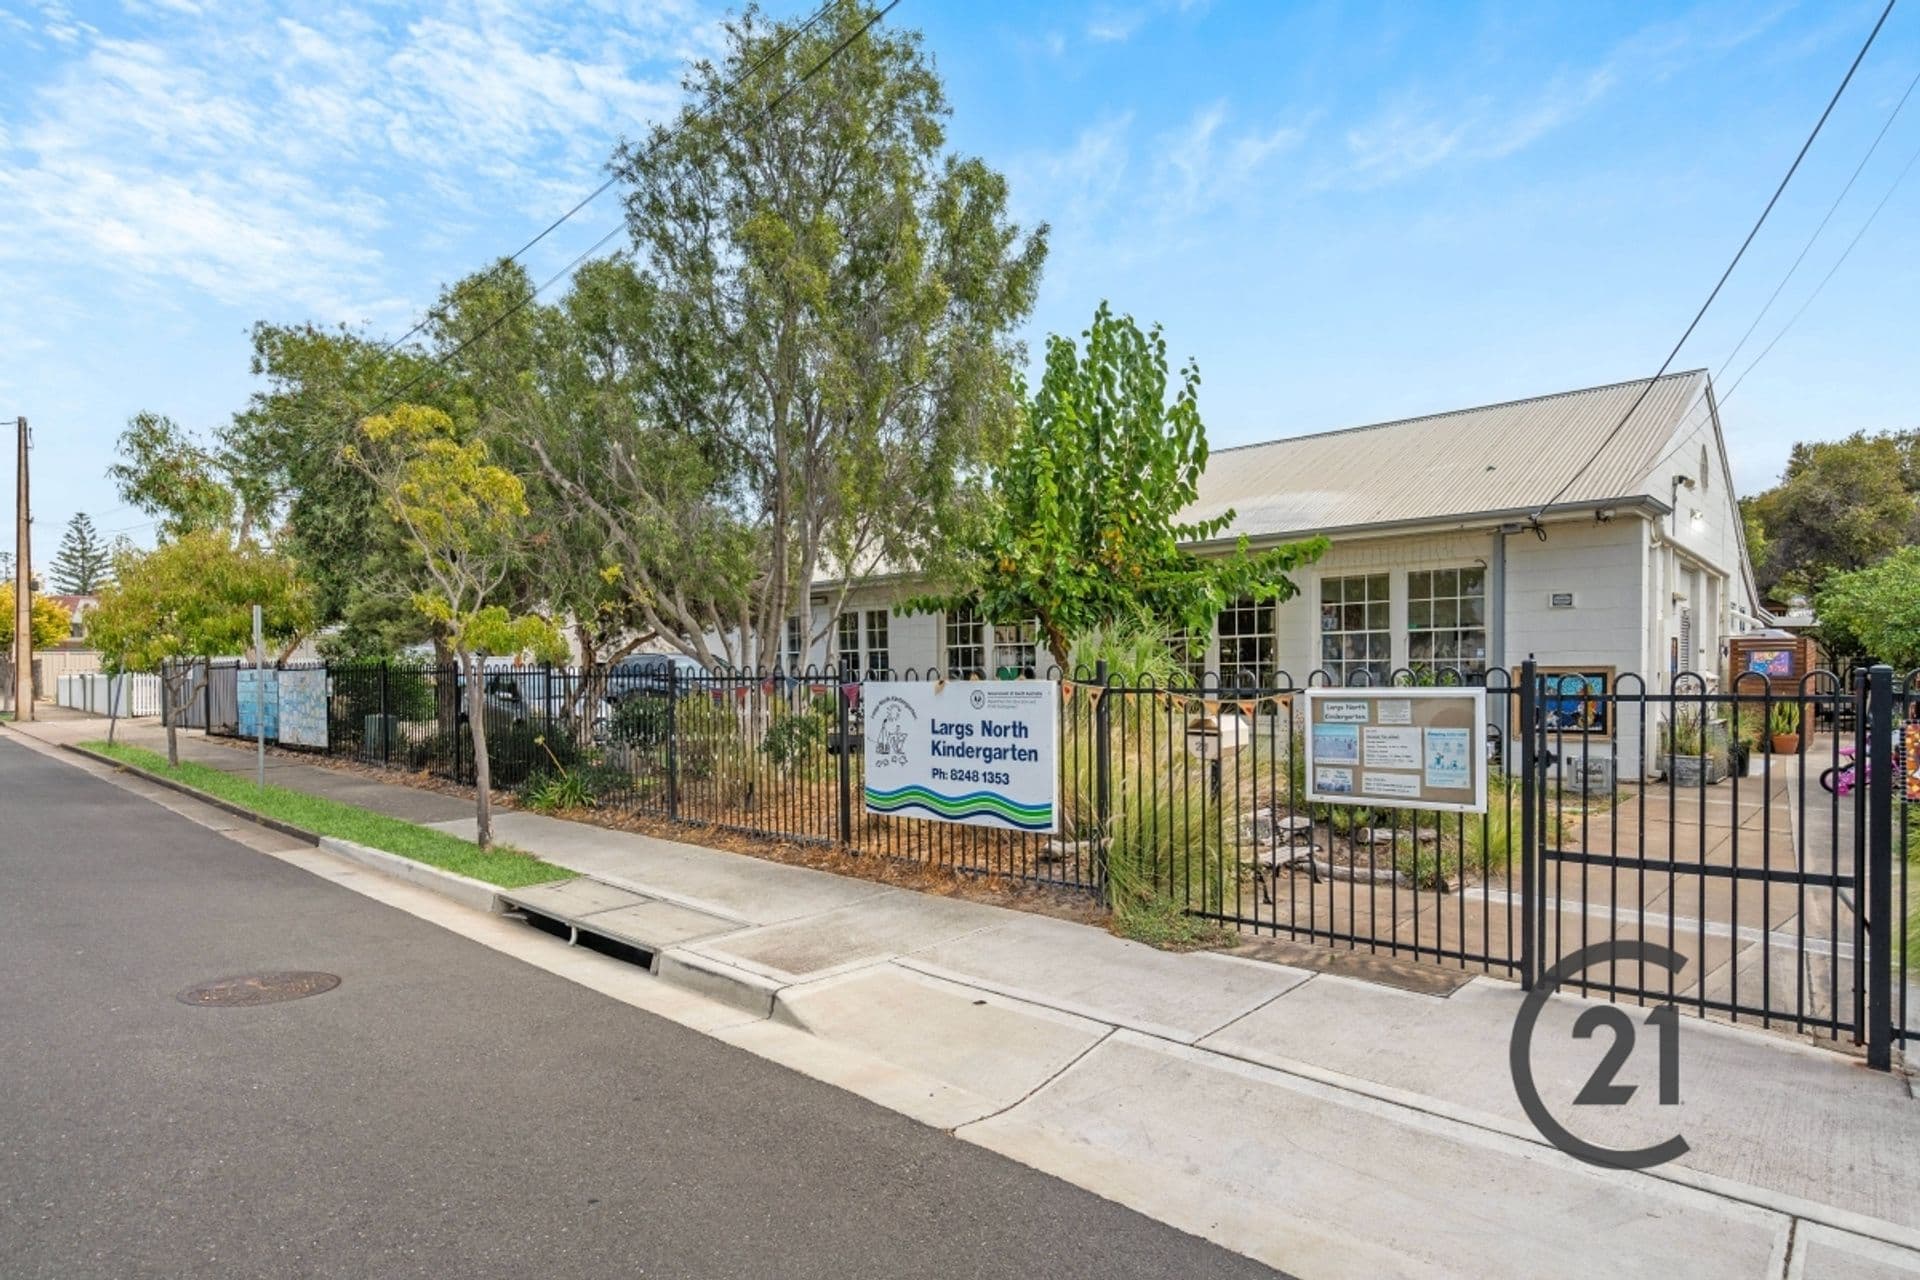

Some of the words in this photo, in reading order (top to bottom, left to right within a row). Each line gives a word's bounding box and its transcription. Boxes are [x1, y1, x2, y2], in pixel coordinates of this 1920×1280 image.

[931, 718, 974, 739] Largs
[981, 720, 1028, 738] North
[931, 740, 1038, 763] Kindergarten
[932, 768, 948, 780] Ph:
[950, 768, 979, 782] 8248
[982, 771, 1010, 785] 1353
